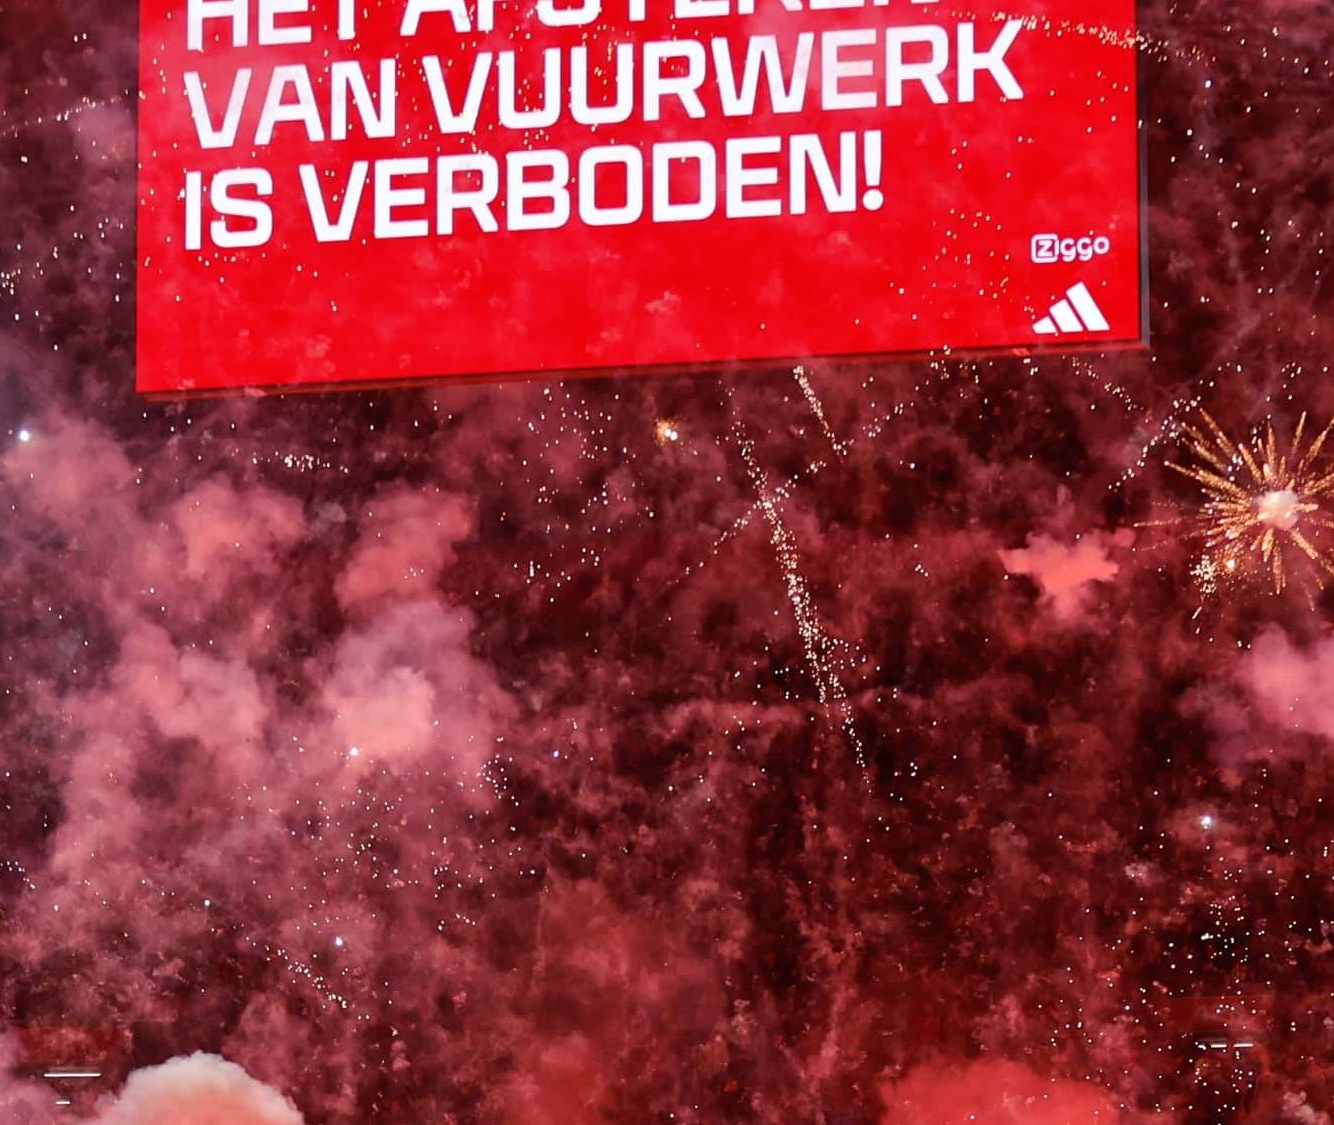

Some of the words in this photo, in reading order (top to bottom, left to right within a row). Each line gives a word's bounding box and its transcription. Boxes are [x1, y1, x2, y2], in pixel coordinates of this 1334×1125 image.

[183, 58, 396, 149] VAN
[422, 19, 1025, 134] VUURWERK
[185, 167, 273, 250] IS
[299, 129, 884, 243] VERBODEN!
